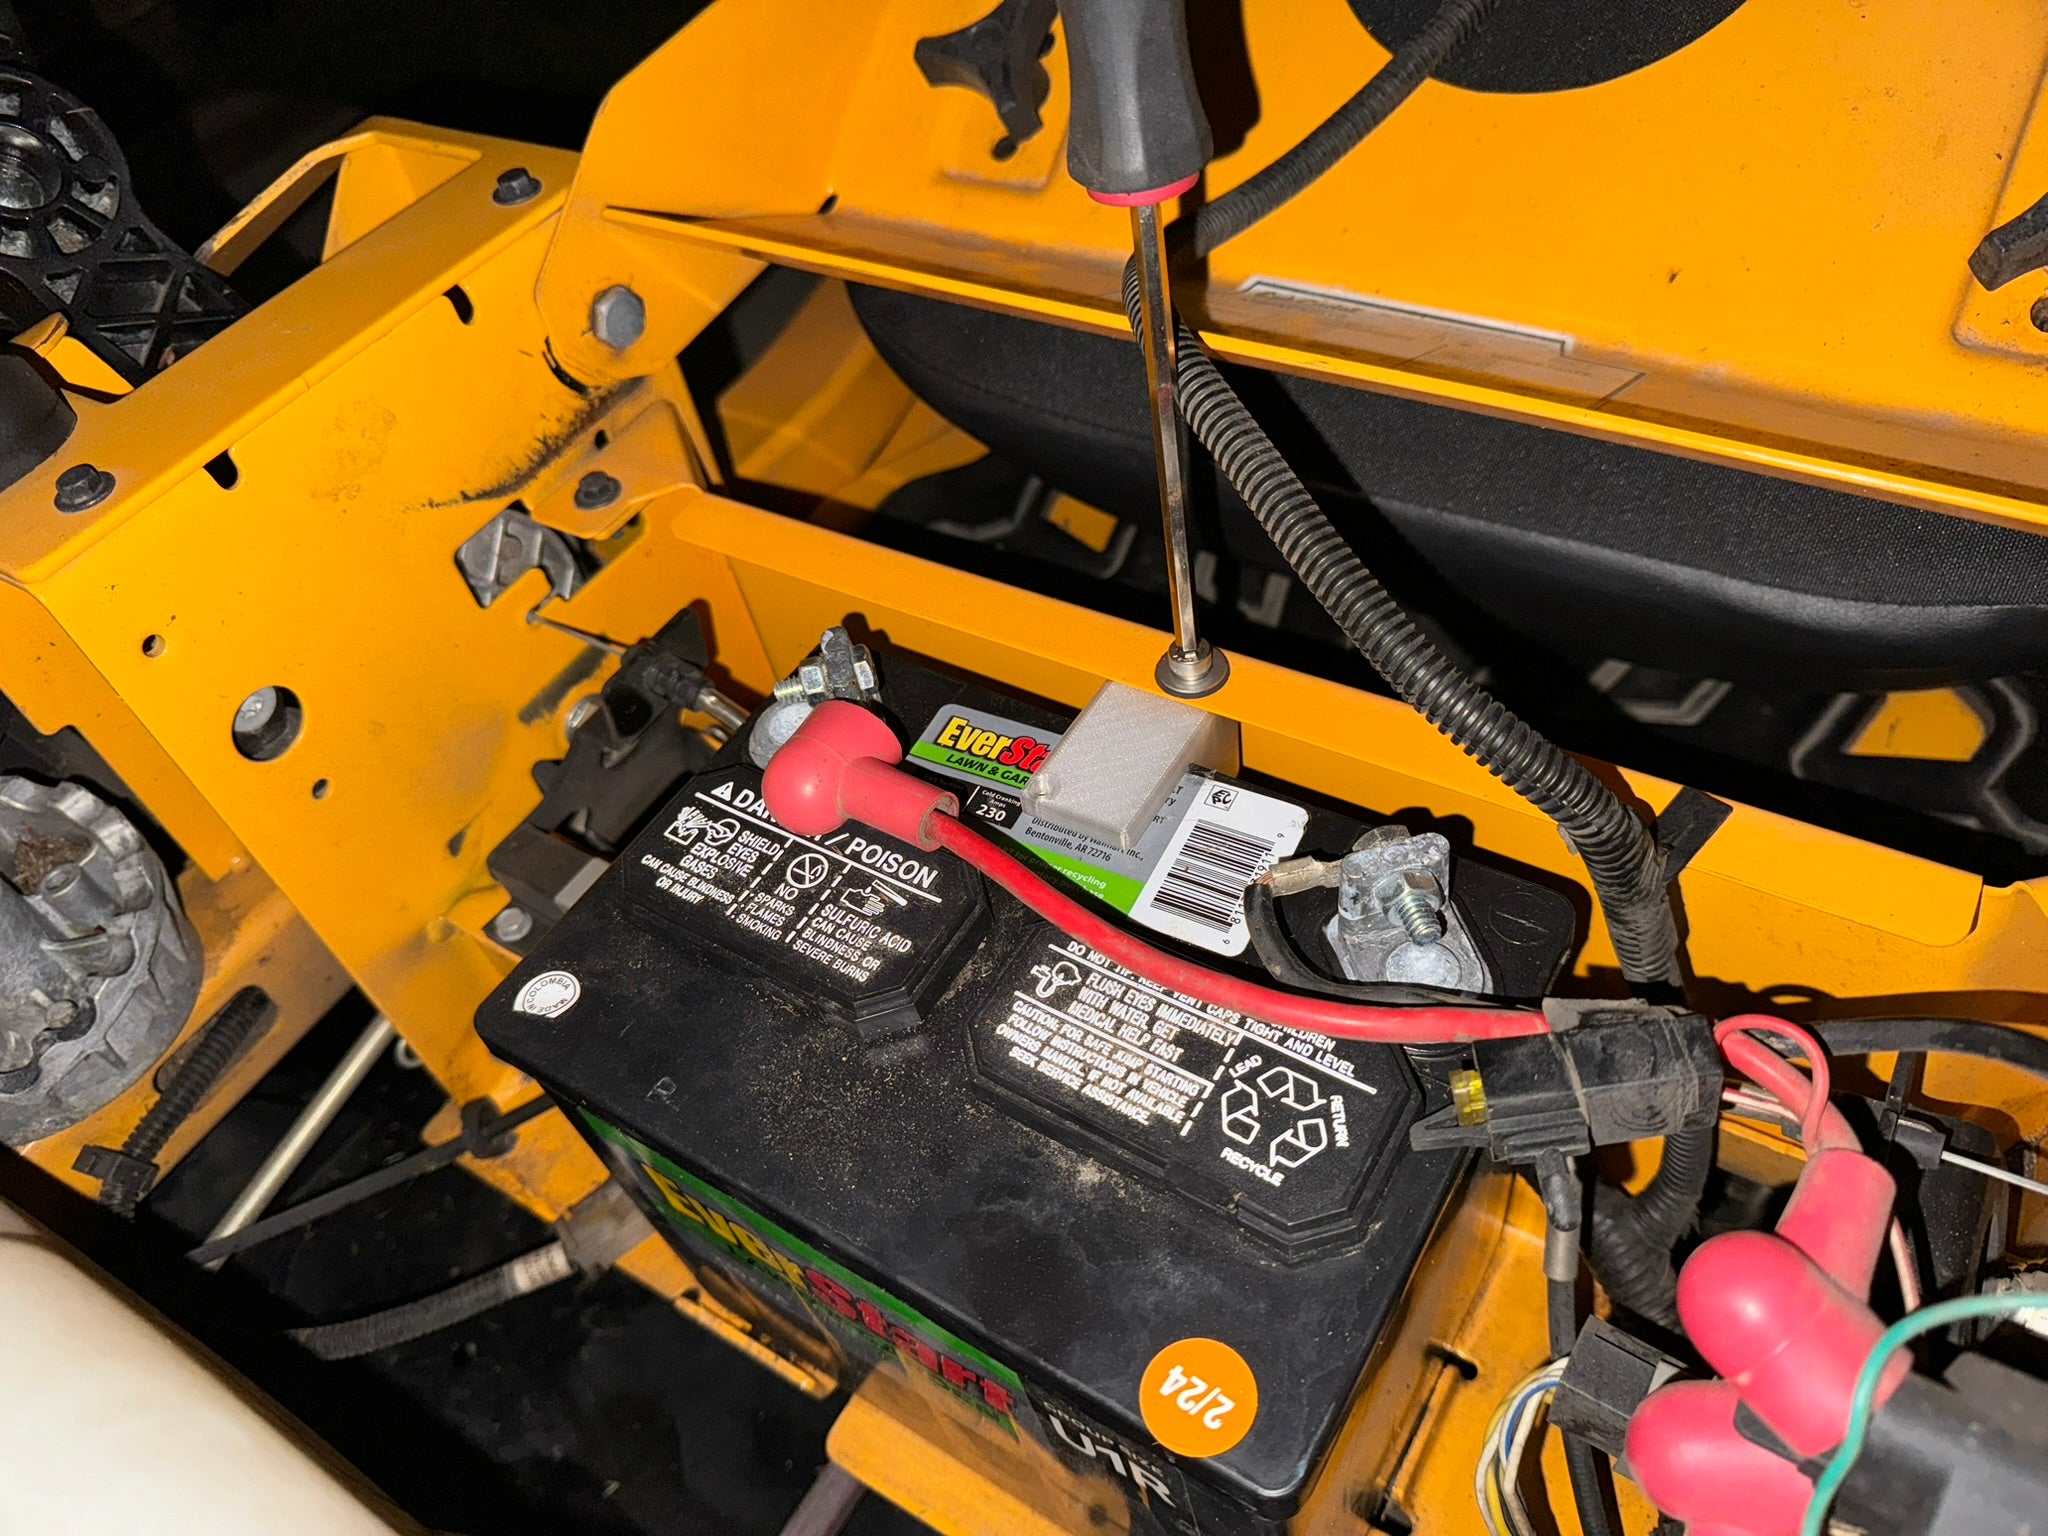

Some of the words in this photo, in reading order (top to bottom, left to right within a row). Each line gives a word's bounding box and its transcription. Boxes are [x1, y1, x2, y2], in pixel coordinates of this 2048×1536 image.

[936, 716, 1052, 774] EverSt
[945, 754, 987, 773] LAWN
[987, 766, 1001, 777] &
[1001, 769, 1031, 786] GAR
[975, 803, 1006, 822] 230
[982, 789, 996, 798] Cold
[995, 793, 1021, 807] Cranking
[989, 799, 1006, 808] Amps
[690, 842, 754, 878] EXPLOSIVE
[727, 842, 760, 864] EYES
[737, 830, 781, 855] SHIELD
[1025, 826, 1073, 850] Bentonville,
[1075, 843, 1089, 853] AR
[1088, 847, 1112, 862] 72716
[640, 854, 661, 870] CAN
[659, 863, 689, 882] CAUSE
[687, 876, 735, 905] BLINDNESS
[679, 854, 719, 880] GASES
[844, 837, 939, 889] POISON
[1062, 867, 1107, 889] recycling
[655, 876, 670, 890] OR
[671, 883, 705, 905] INJURY
[755, 892, 796, 917] SPARKS
[774, 882, 799, 901] NO
[736, 913, 782, 941] SMOKING
[745, 902, 786, 927] FLAMES
[821, 903, 881, 940] SULFURIC
[878, 931, 913, 953] ACID
[802, 928, 862, 962] BLINDNESS
[862, 956, 881, 972] OR
[811, 916, 837, 934] CAN
[835, 928, 874, 951] CAUSE
[792, 940, 834, 965] SEVERE
[832, 959, 870, 983] BURNS
[527, 976, 571, 1004] COLOMBIA
[527, 1003, 537, 1012] IN
[536, 997, 568, 1013] MADE
[1066, 940, 1084, 955] DO
[1087, 951, 1111, 968] NOT
[1172, 991, 1203, 1009] VENT
[1206, 1004, 1242, 1025] CAPS
[1245, 1018, 1284, 1043] TIGHT
[1283, 1037, 1314, 1058] AND
[1315, 1051, 1356, 1078] LEVEL
[1078, 986, 1109, 1010] WITH
[1152, 1019, 1181, 1041] GET
[1085, 972, 1123, 999] FLUSH
[1124, 988, 1157, 1011] EYES
[1155, 1002, 1237, 1047] IMMEDIATELY
[1067, 1000, 1119, 1034] MEDICAL
[1117, 1022, 1151, 1047] HELP
[1149, 1038, 1185, 1063] FAST
[1270, 1022, 1336, 1052] ILDREN
[995, 1023, 1042, 1053] OWNERS
[1087, 1068, 1103, 1082] IF
[1100, 1075, 1128, 1095] NOT
[1125, 1085, 1187, 1125] AVAILABLE
[1007, 1013, 1053, 1042] FOLLOW
[1050, 1033, 1128, 1079] INSTRUCTIONS
[1126, 1071, 1142, 1086] IN
[1141, 1077, 1189, 1109] VEHICLE
[1009, 1045, 1040, 1068] SEEK
[1037, 1060, 1084, 1091] SERVICE
[1060, 1023, 1084, 1043] FOR
[1083, 1034, 1114, 1056] SAFE
[1112, 1048, 1144, 1070] JUMP
[1143, 1063, 1200, 1097] STARTING
[1228, 1054, 1263, 1079] LEAD
[1330, 1094, 1350, 1148] RETURN
[1220, 1146, 1285, 1187] RECYCLE
[642, 1163, 1015, 1414] EverStart
[1159, 1364, 1236, 1431] 2/24
[1049, 1413, 1177, 1509] U1R
